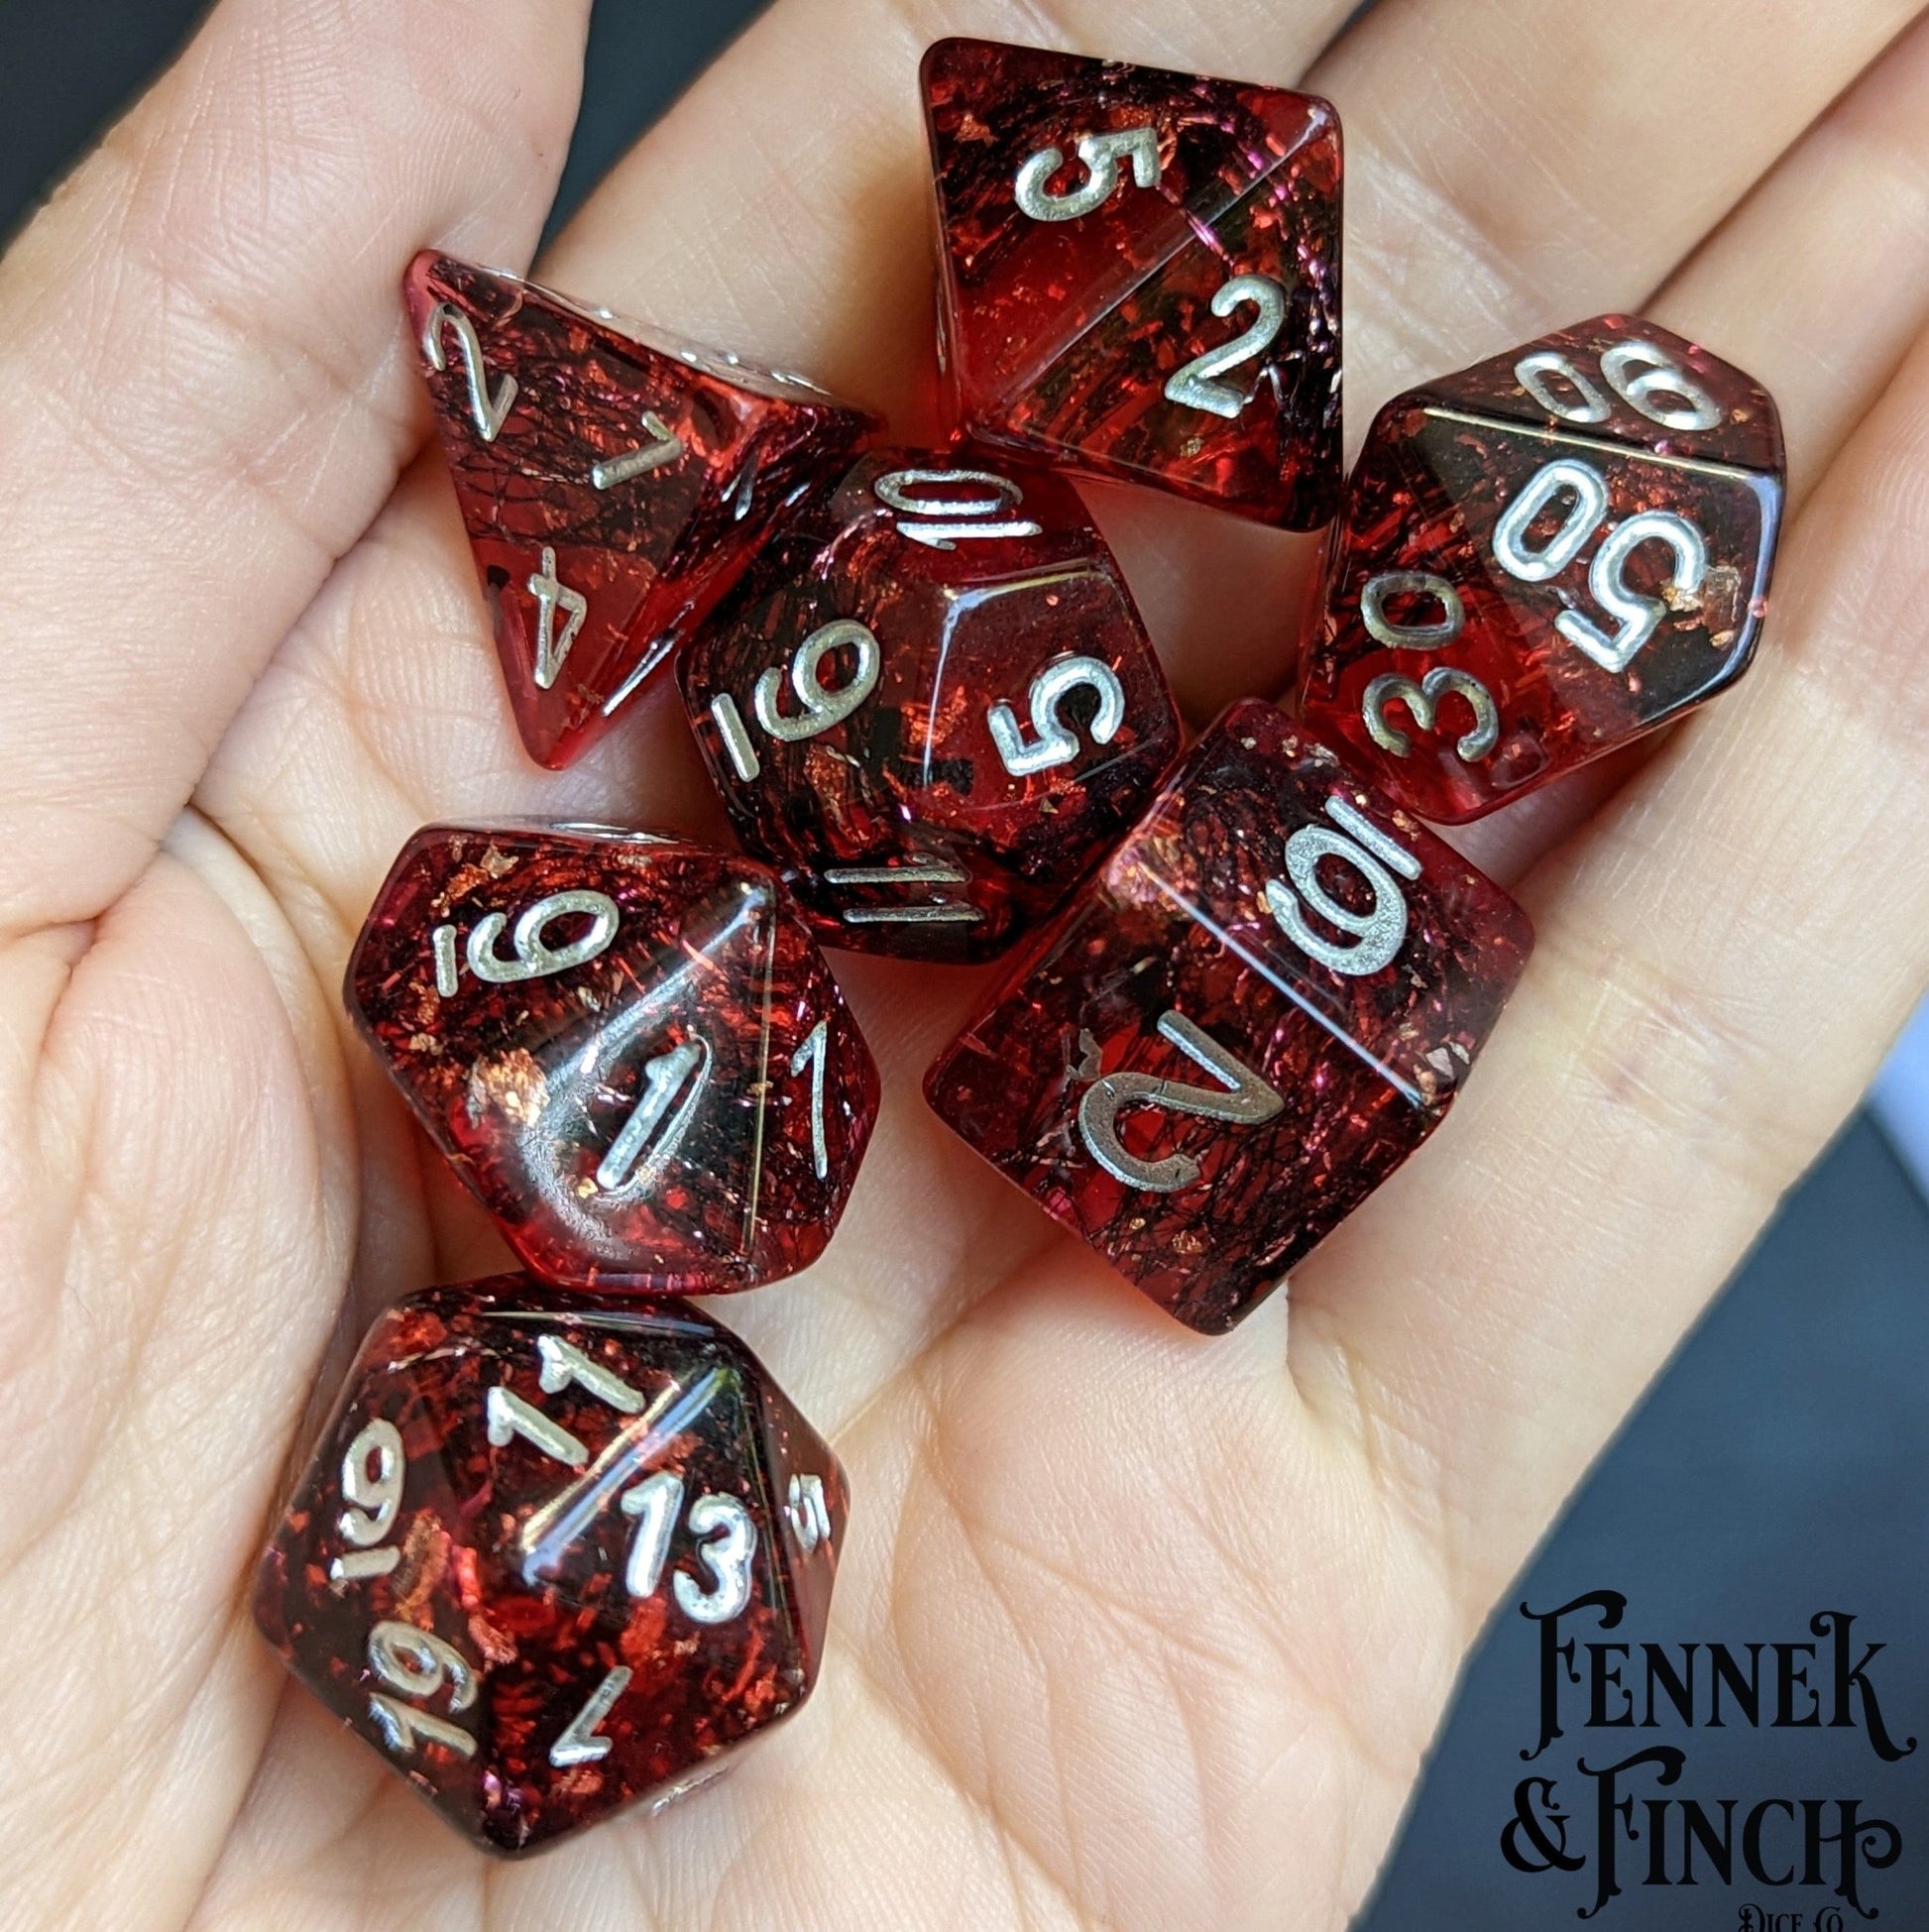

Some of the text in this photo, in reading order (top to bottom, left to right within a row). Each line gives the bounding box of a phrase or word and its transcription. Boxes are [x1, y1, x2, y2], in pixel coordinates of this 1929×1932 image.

[1014, 127, 1162, 222] 5
[422, 302, 518, 442] 2
[1164, 274, 1289, 419] 2
[873, 469, 1044, 551] 10
[1492, 458, 1708, 674] 50
[527, 546, 588, 690] 4
[1360, 570, 1500, 763] 30
[987, 654, 1125, 777] 5
[1078, 1008, 1285, 1193] 2
[487, 1334, 646, 1467] 11
[621, 1469, 758, 1624] 13
[368, 1620, 479, 1759] 19
